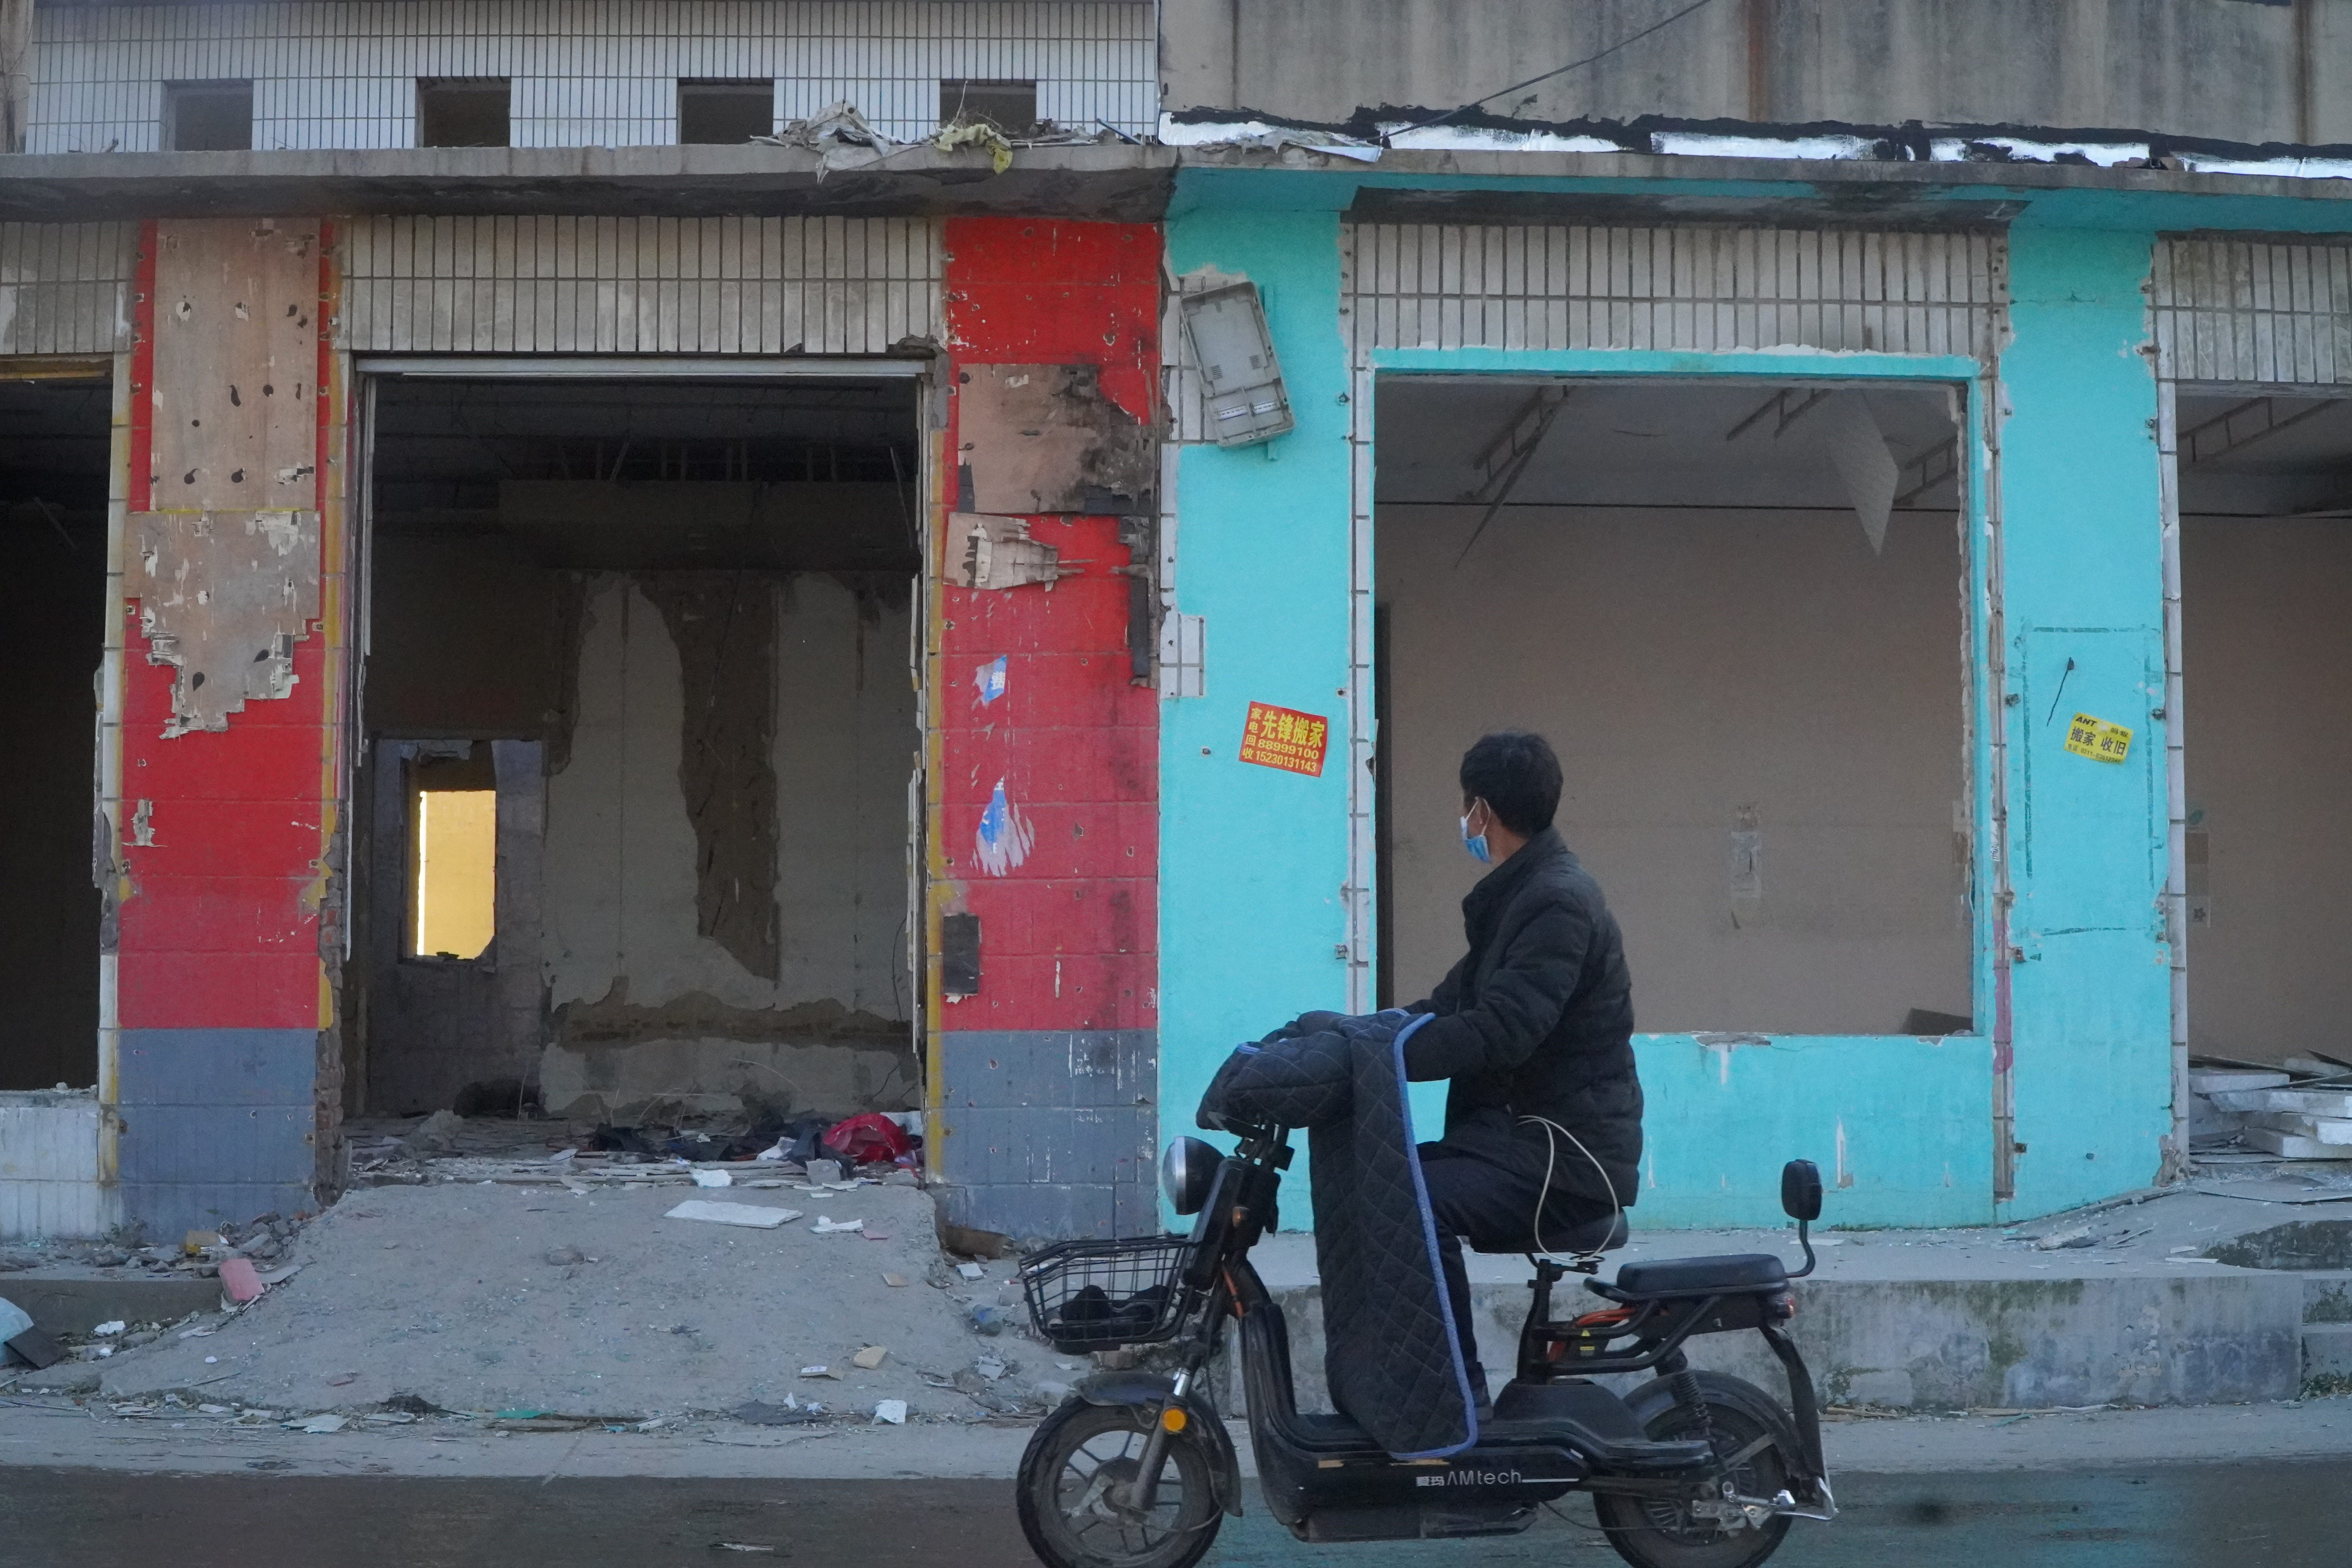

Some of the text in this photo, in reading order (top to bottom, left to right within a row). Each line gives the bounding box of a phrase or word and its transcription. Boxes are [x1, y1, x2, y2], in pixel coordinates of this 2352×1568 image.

[1242, 708, 1263, 760] 家电回收
[1260, 710, 1325, 748] 先锋搬家
[2076, 716, 2097, 727] ANT
[1257, 739, 1319, 760] 88999100
[2070, 726, 2126, 756] 搬家 收旧
[1256, 750, 1317, 772] 15230131143
